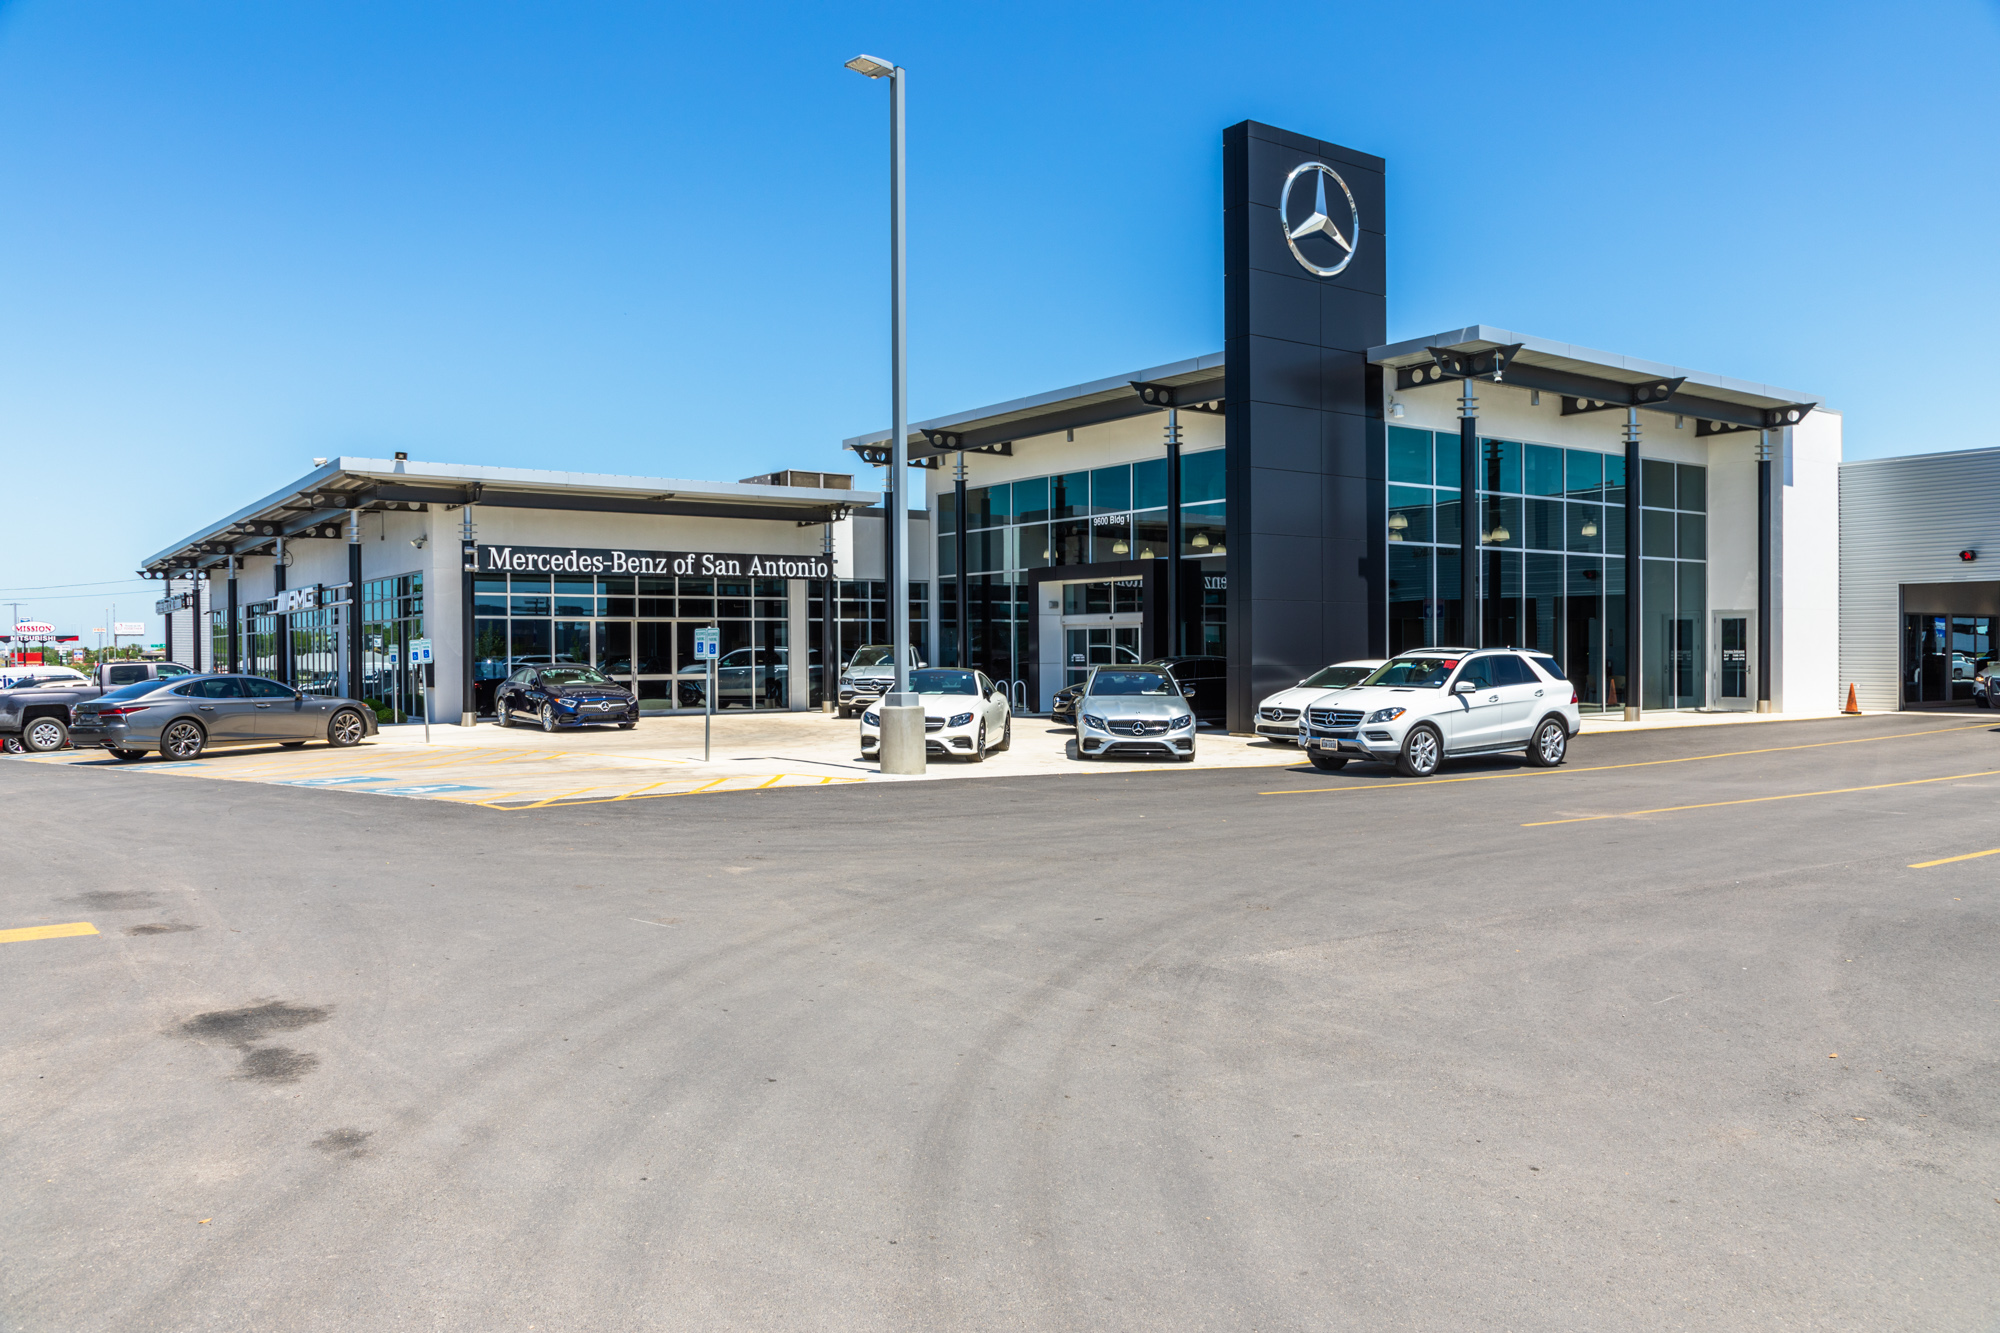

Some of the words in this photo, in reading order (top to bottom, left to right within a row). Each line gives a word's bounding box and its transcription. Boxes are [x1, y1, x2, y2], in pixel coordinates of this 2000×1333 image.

[1110, 515, 1124, 525] Bldg
[1126, 514, 1130, 522] 1
[487, 546, 667, 574] Mercedes-Benz
[674, 554, 696, 575] of
[702, 554, 742, 576] San
[749, 555, 831, 578] Antonio
[288, 587, 313, 610] AMG
